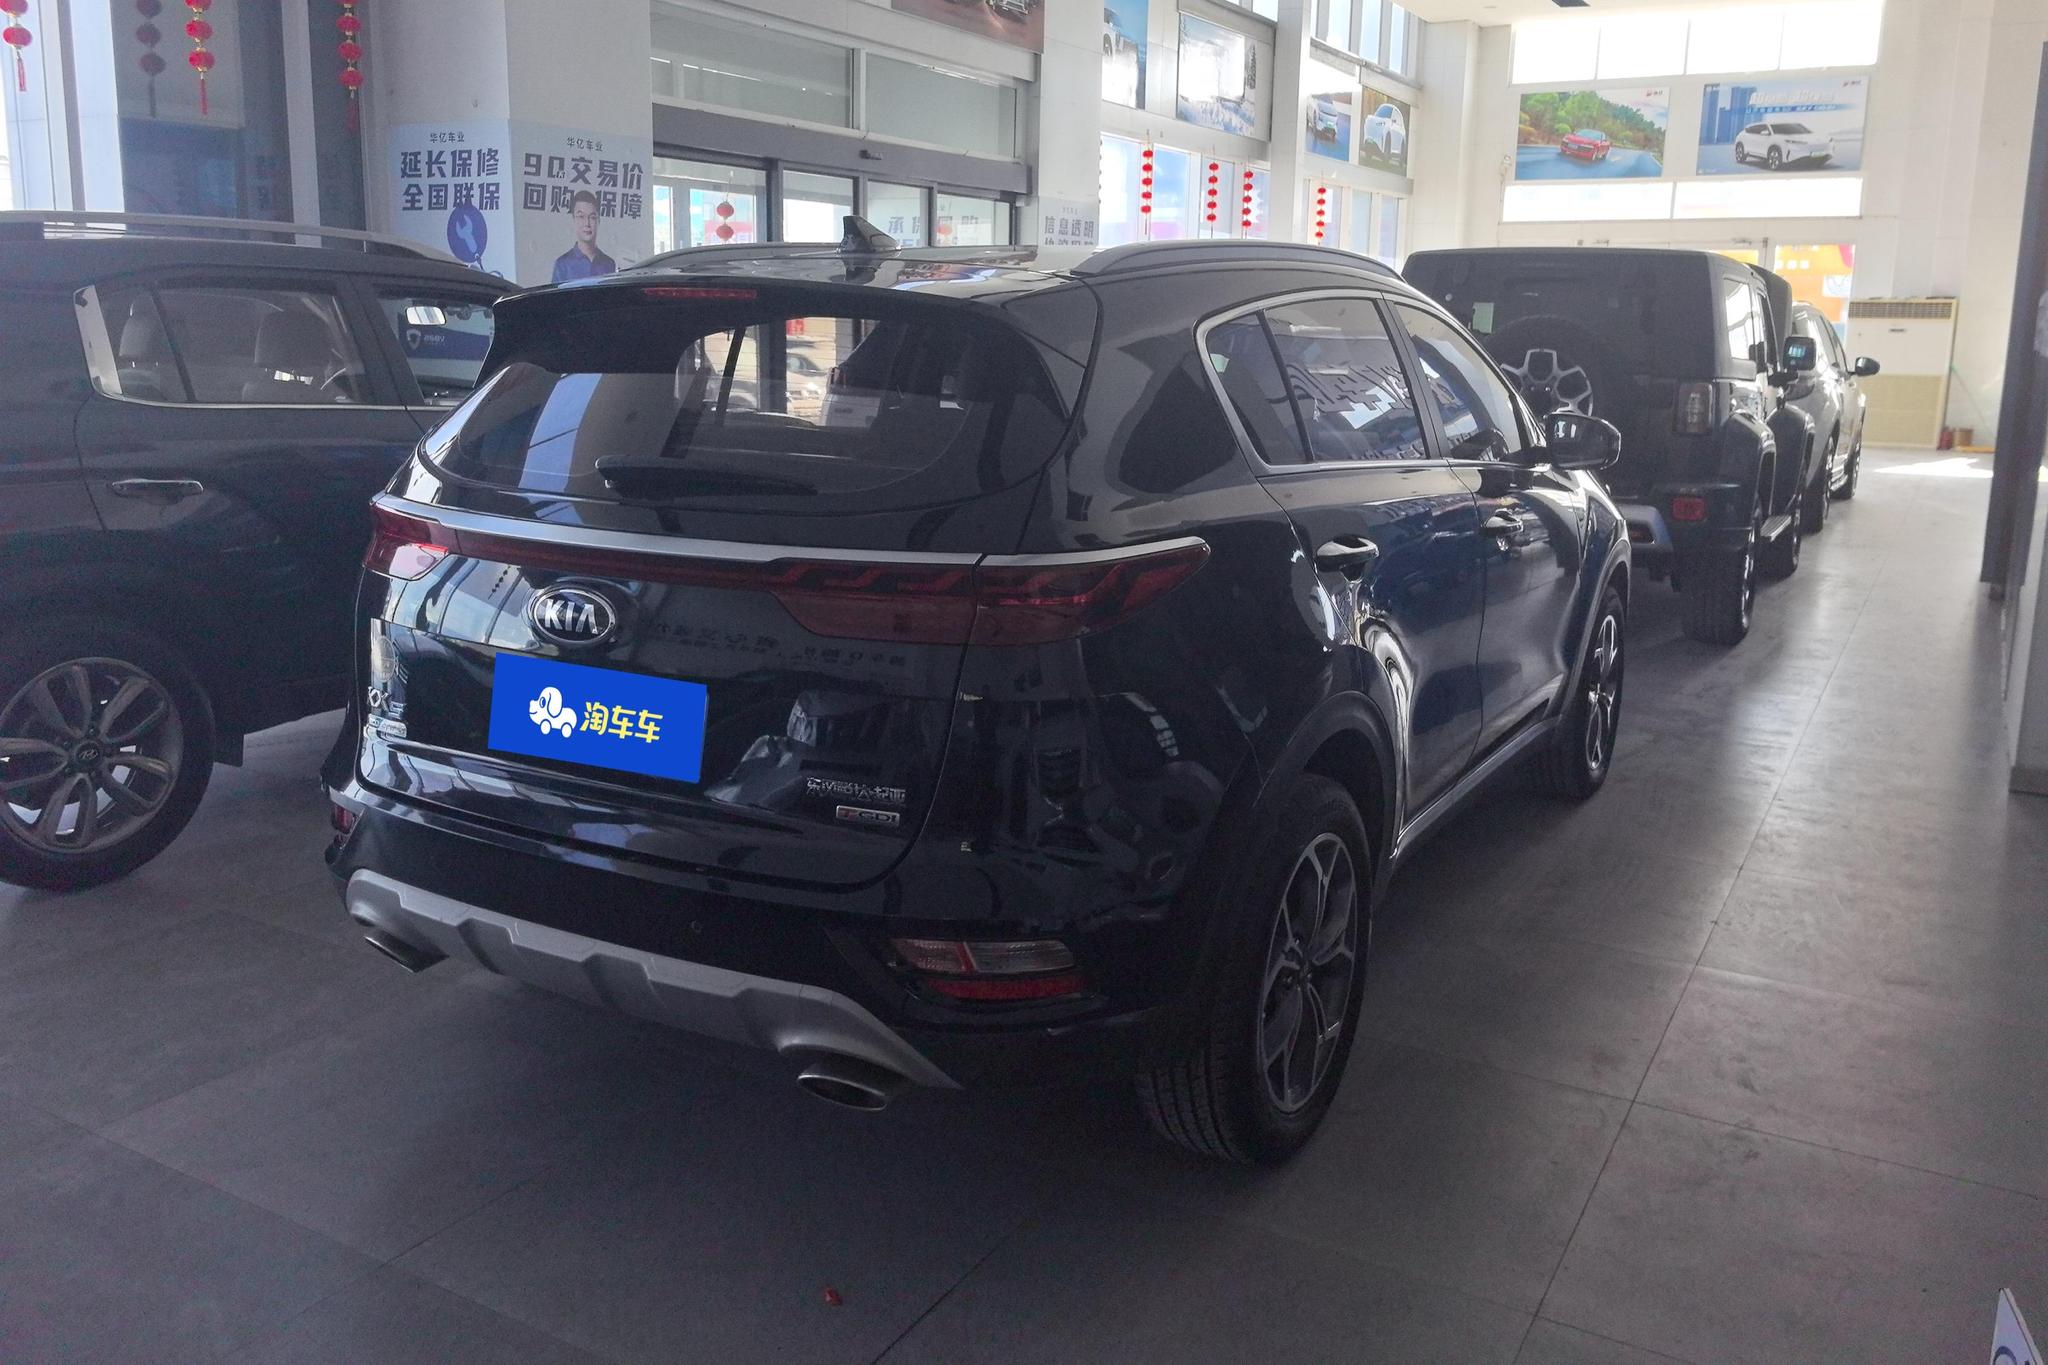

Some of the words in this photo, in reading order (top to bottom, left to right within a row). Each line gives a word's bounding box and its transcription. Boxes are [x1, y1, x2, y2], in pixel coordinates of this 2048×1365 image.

[430, 131, 465, 143] 华亿车业
[566, 136, 603, 152] 华亿车业
[400, 148, 499, 179] 延长保修
[402, 182, 500, 211] 全国联保
[1044, 215, 1095, 239] 信息透明
[544, 598, 598, 635] KIA
